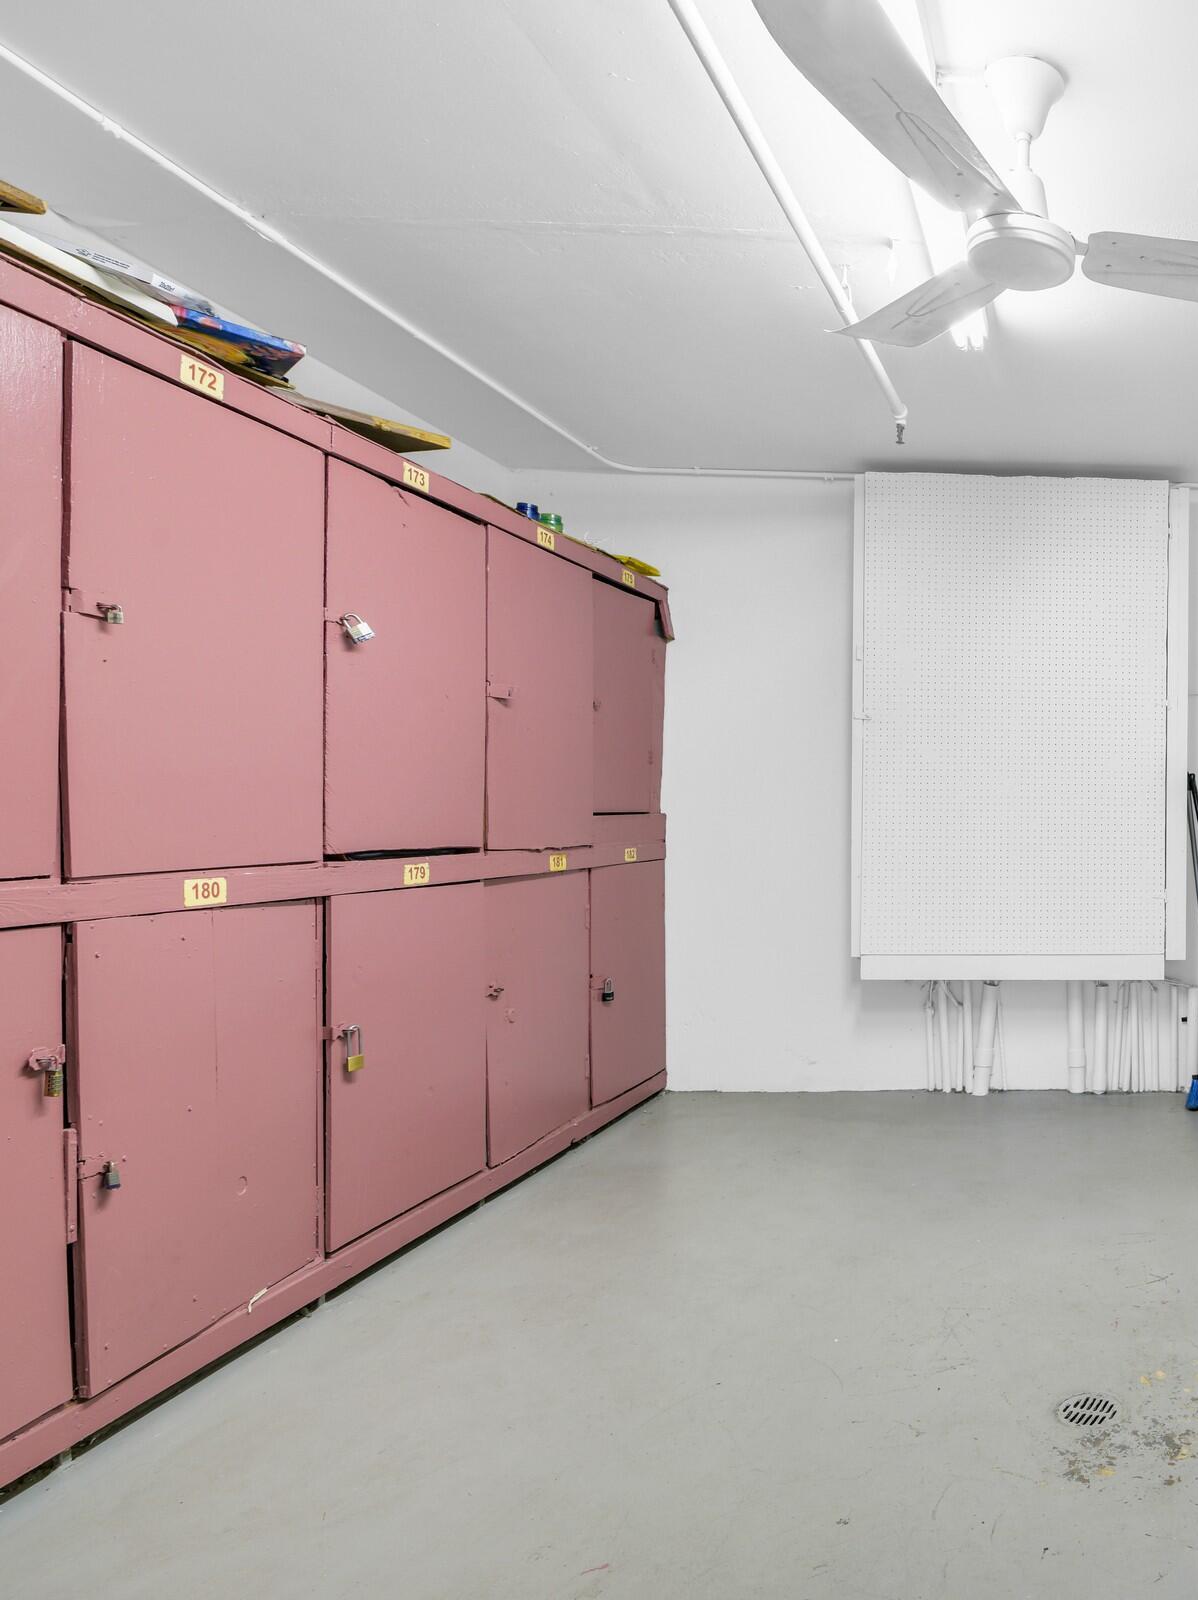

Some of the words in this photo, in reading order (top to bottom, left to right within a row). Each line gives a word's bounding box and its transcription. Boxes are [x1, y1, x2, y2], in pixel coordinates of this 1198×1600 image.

[189, 363, 217, 391] 172
[408, 468, 425, 486] 173
[540, 531, 552, 546] 174
[552, 856, 564, 868] 181
[408, 866, 426, 880] 179
[192, 881, 220, 900] 180
